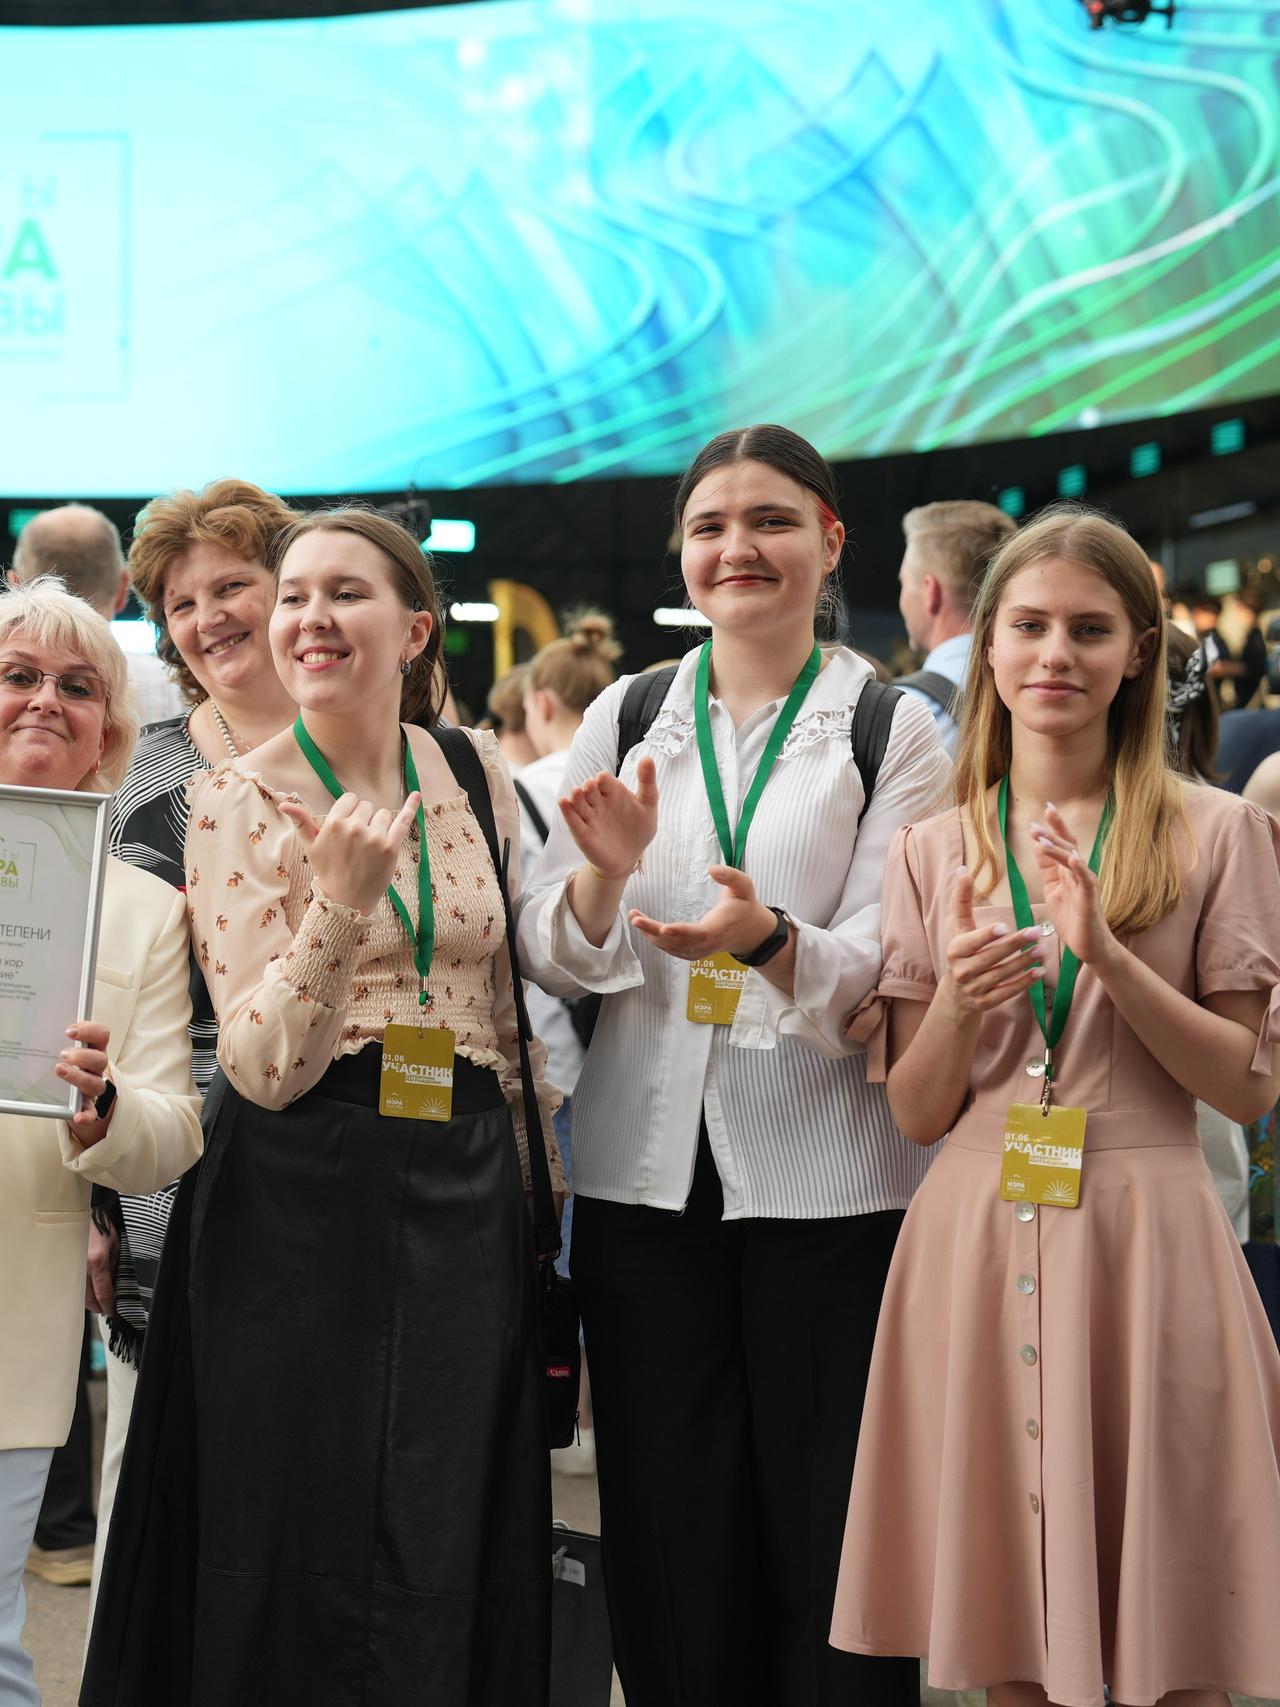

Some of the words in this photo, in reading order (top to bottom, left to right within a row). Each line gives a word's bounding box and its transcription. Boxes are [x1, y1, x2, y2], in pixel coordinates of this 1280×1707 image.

[4, 959, 23, 968] хор
[691, 960, 714, 968] 01.06
[691, 967, 748, 981] УЧАСТН
[382, 1053, 404, 1062] 01.06
[382, 1062, 453, 1078] УЧАСТНИК
[1004, 1133, 1029, 1141] 01.06
[1004, 1141, 1082, 1159] УЧАСТНИК
